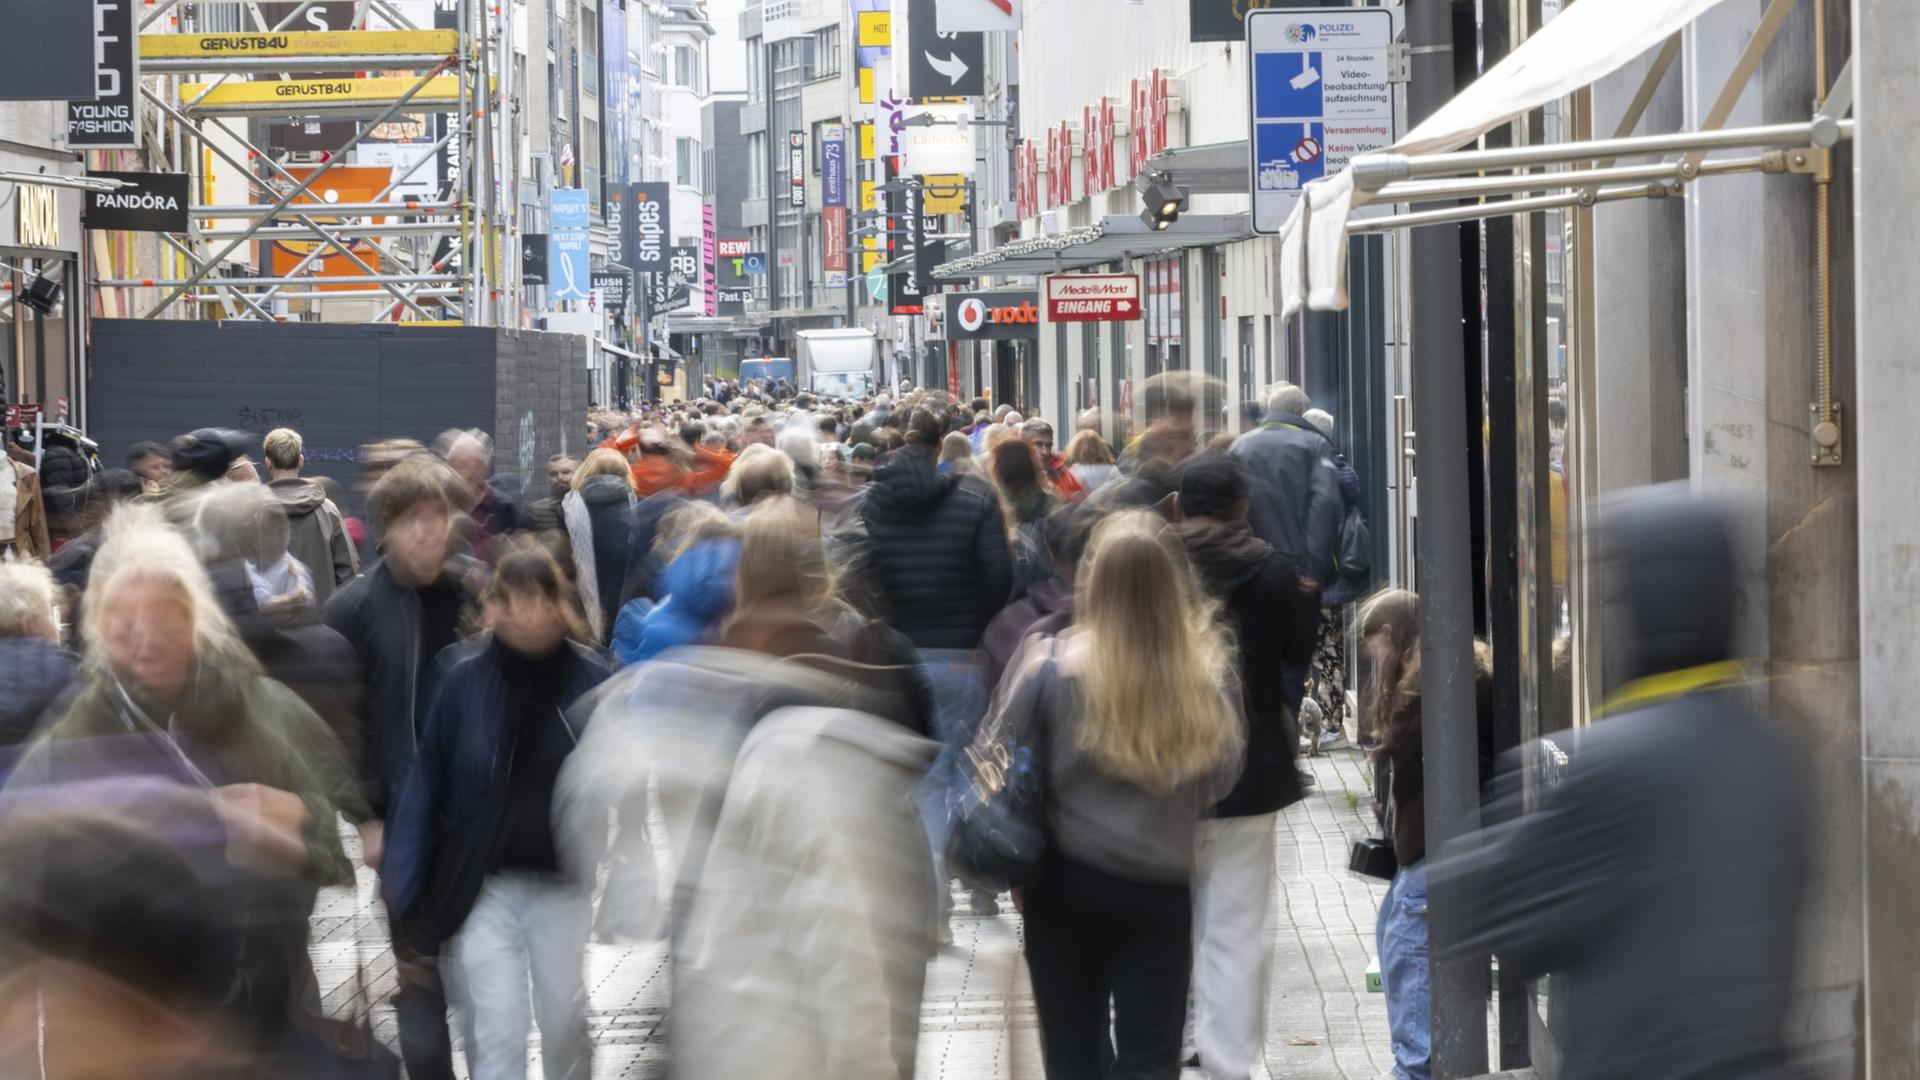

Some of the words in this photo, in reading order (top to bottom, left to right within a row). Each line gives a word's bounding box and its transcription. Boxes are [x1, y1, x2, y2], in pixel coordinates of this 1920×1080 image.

[1319, 24, 1354, 32] POLIZEI
[1340, 70, 1371, 79] Video-
[1324, 94, 1388, 104] aufzeichnung
[72, 105, 129, 118] YOUNG
[69, 120, 134, 135] FASHION
[1324, 125, 1390, 135] Versammlung:
[826, 143, 840, 159] 73
[1328, 143, 1355, 152] Keine
[96, 192, 179, 211] PANDORA
[792, 185, 803, 205] FOOT
[639, 201, 664, 261] snipes
[594, 278, 623, 287] LUSH
[1056, 300, 1111, 314] EINGANG
